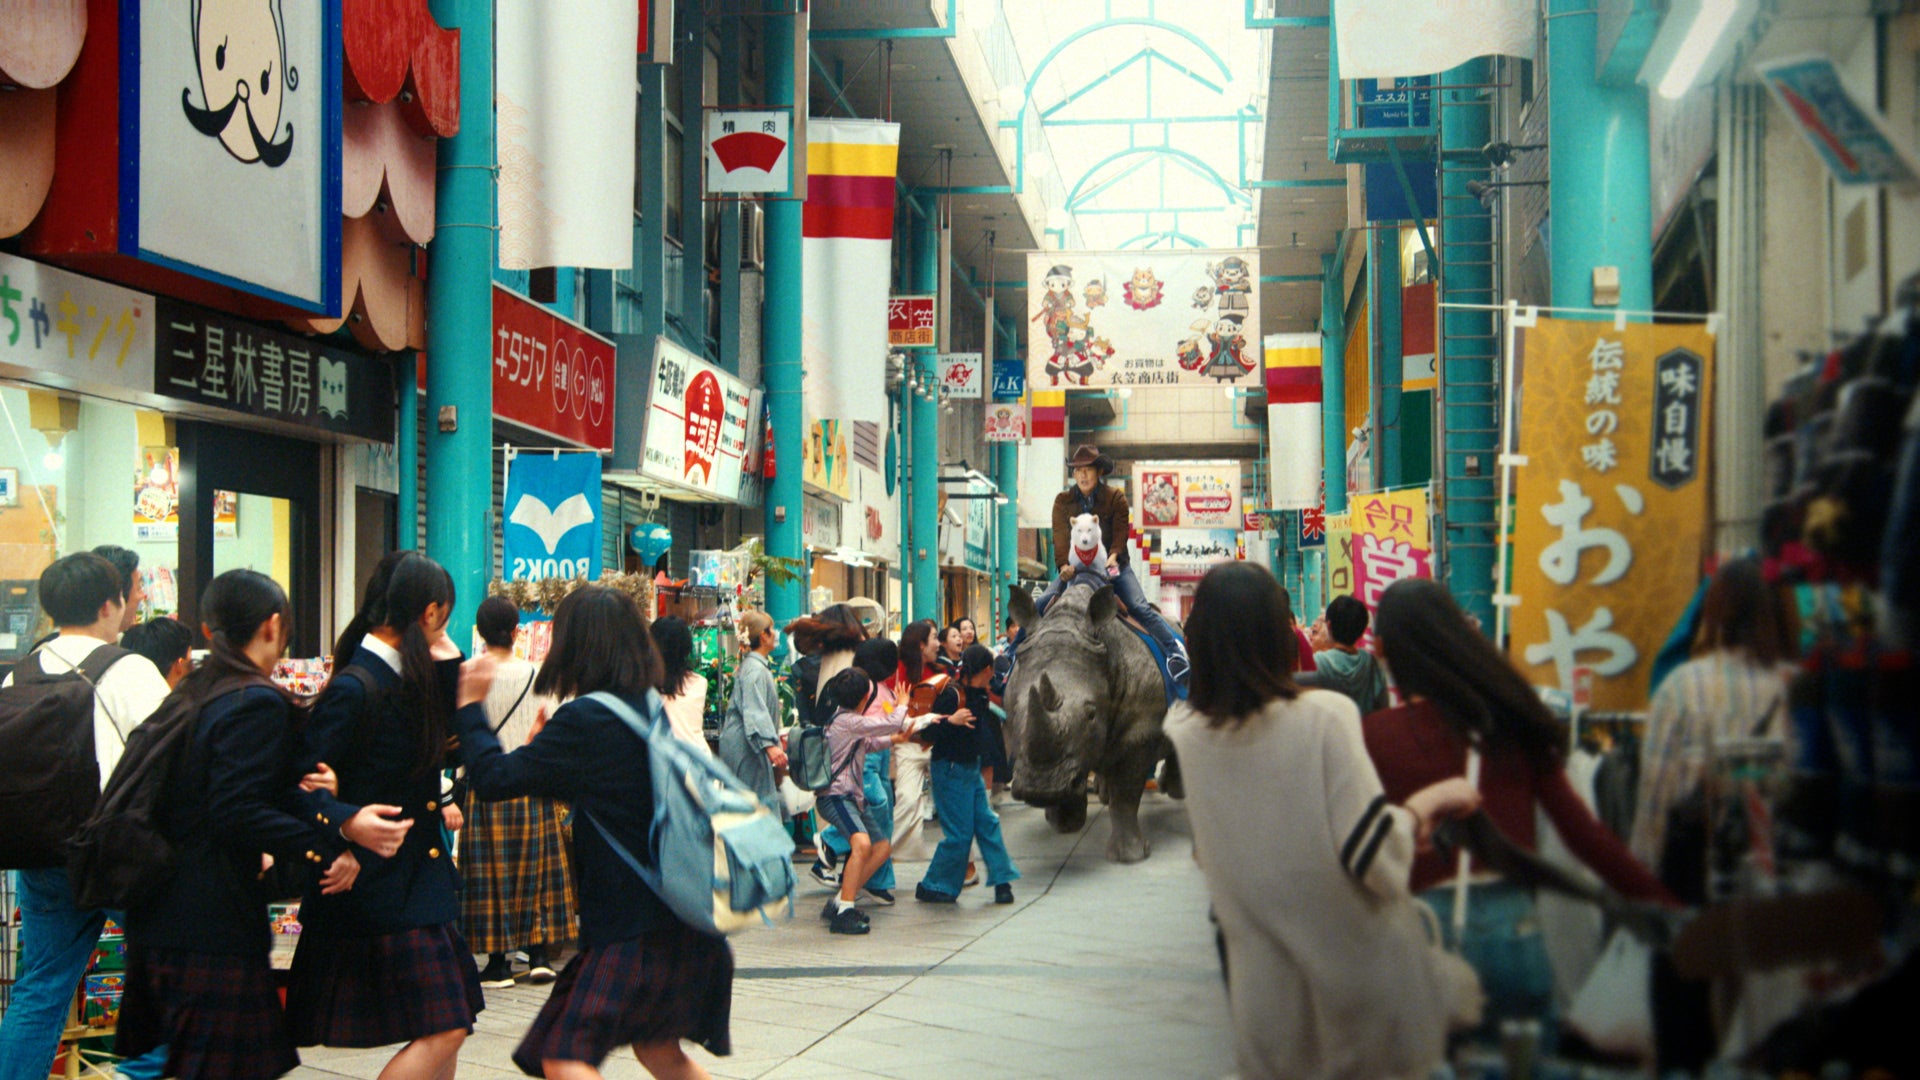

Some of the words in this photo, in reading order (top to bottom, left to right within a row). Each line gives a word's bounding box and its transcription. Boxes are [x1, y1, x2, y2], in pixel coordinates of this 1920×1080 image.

[722, 120, 776, 134] 精肉
[889, 331, 931, 344] 商店街
[170, 320, 312, 417] 三星林書房
[573, 370, 585, 396] くつ
[1111, 371, 1179, 385] 衣笠商店街
[1582, 338, 1624, 473] 伝統の味
[1655, 361, 1697, 474] 味自慢
[1524, 479, 1644, 696] おや
